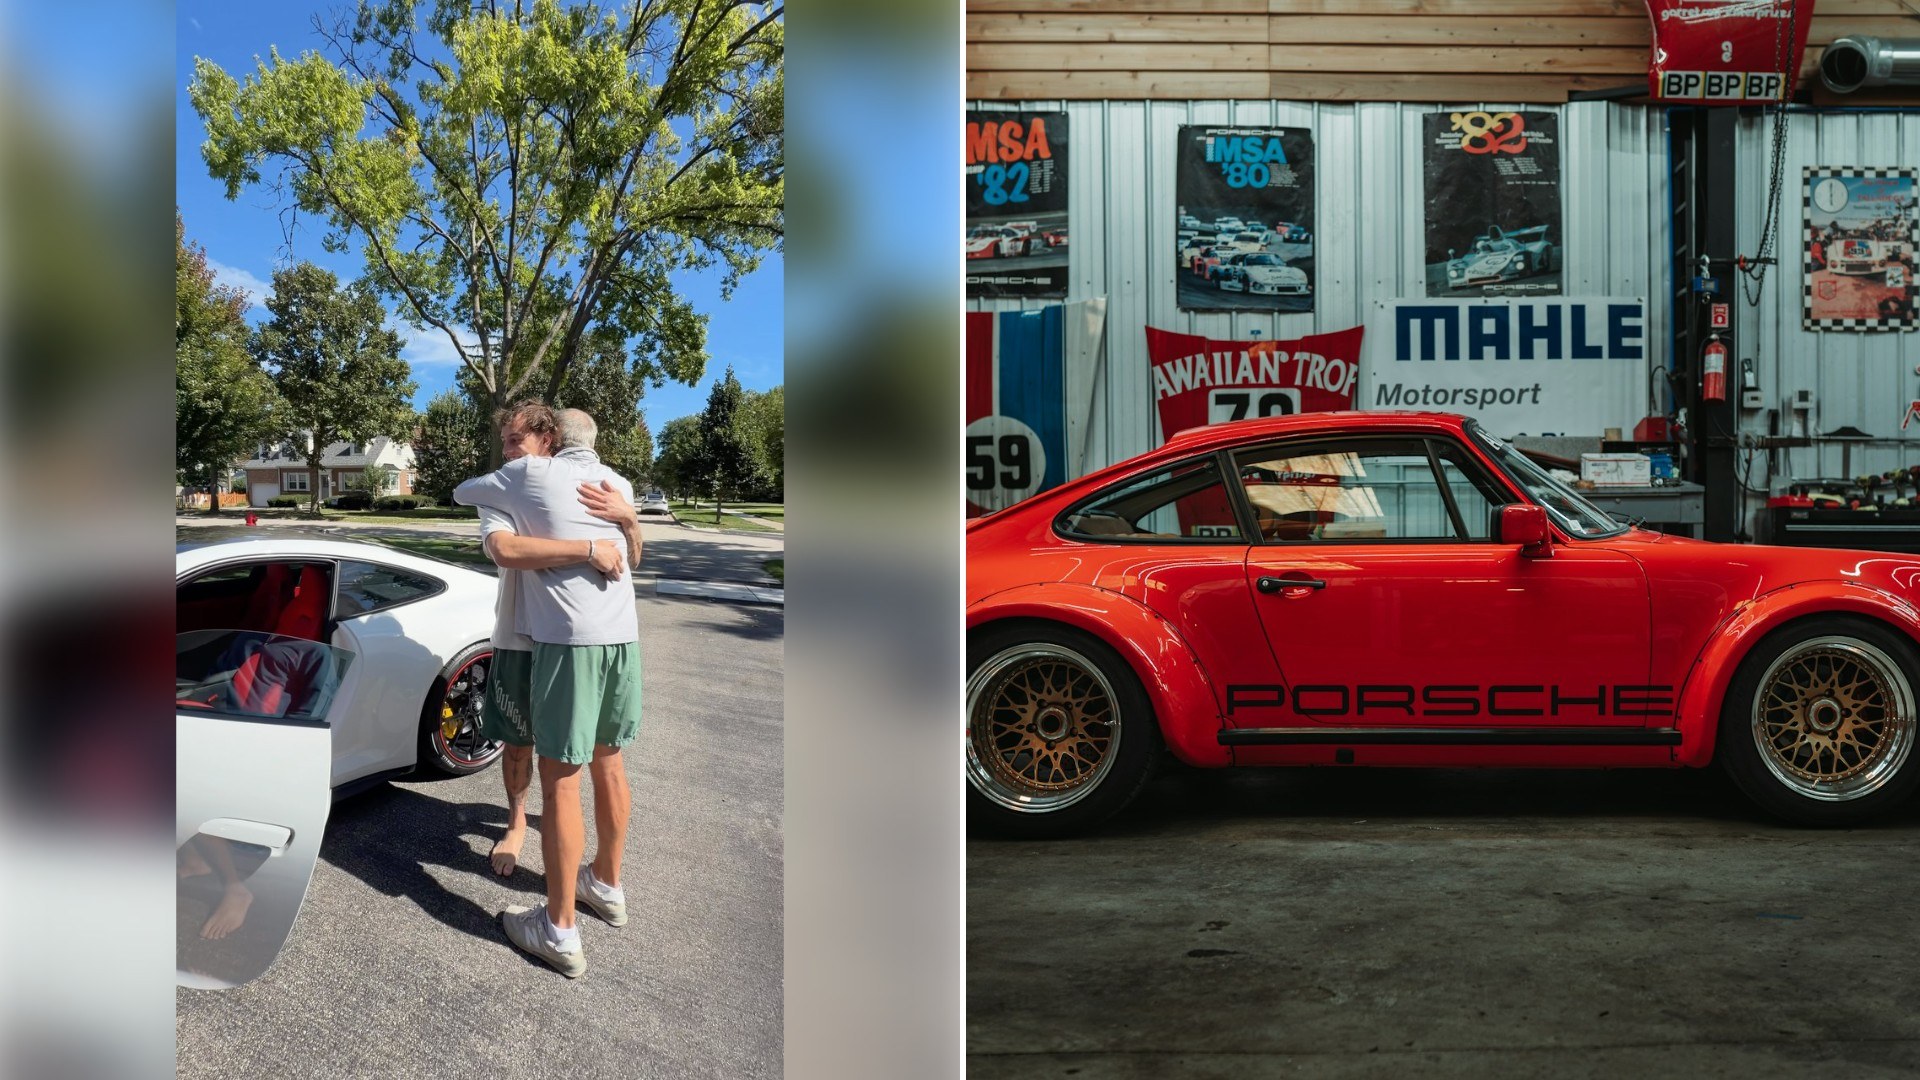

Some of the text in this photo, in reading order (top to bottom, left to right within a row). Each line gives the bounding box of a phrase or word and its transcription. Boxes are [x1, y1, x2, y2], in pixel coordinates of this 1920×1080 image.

[1666, 74, 1780, 97] BP BP BP
[977, 161, 1029, 205] '82
[1222, 162, 1271, 189] '80
[1396, 304, 1643, 361] MAHLE
[1376, 383, 1542, 410] Motorsport
[966, 434, 1031, 490] 59
[1226, 684, 1674, 717] PORSCHE
